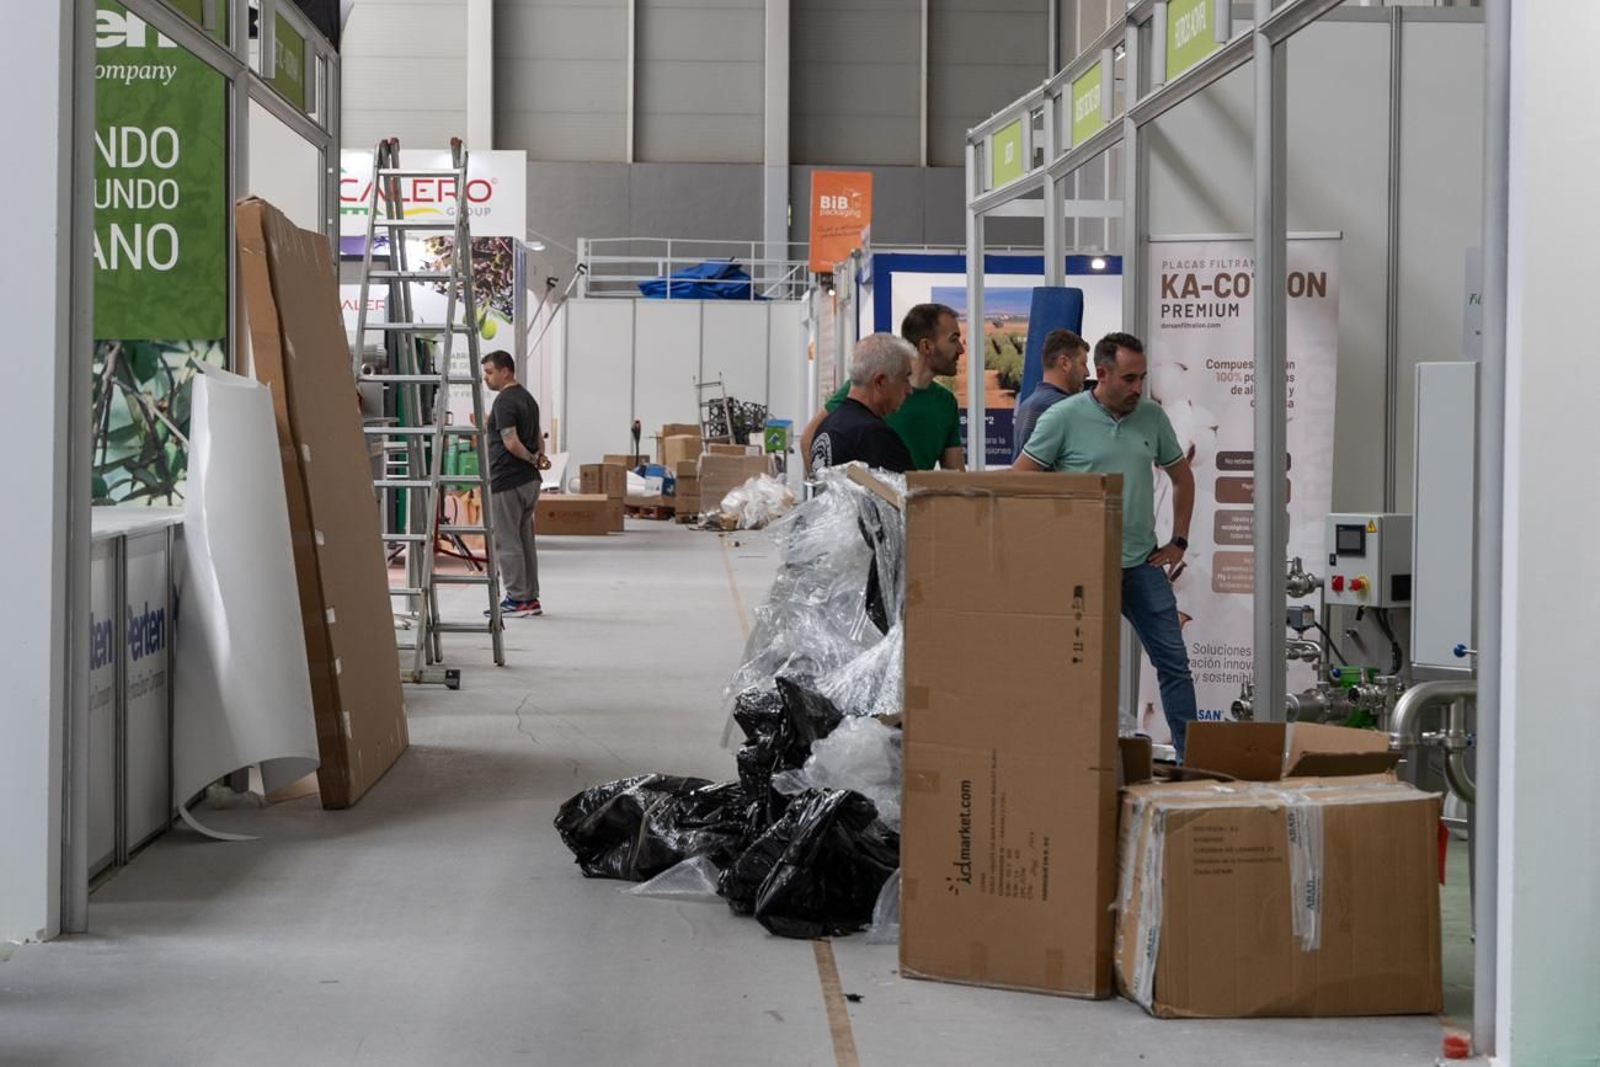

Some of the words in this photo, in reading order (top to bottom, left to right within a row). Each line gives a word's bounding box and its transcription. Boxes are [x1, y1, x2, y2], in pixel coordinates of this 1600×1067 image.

[820, 195, 848, 210] BiB
[446, 207, 492, 217] GOUP
[1162, 260, 1206, 269] PLACAS
[1161, 272, 1327, 299] KA-COON
[1161, 303, 1240, 318] PREMIUM
[1161, 322, 1222, 330] dorsanfiltration.com
[1216, 372, 1243, 383] 100%
[1230, 385, 1243, 395] de
[1288, 387, 1295, 398] y
[1193, 643, 1252, 657] Soluciones
[1194, 674, 1200, 684] y
[1198, 709, 1221, 720] SAN
[952, 780, 972, 885] idmarket.com
[1287, 813, 1297, 843] ABAD
[1305, 880, 1316, 909] ABAD
